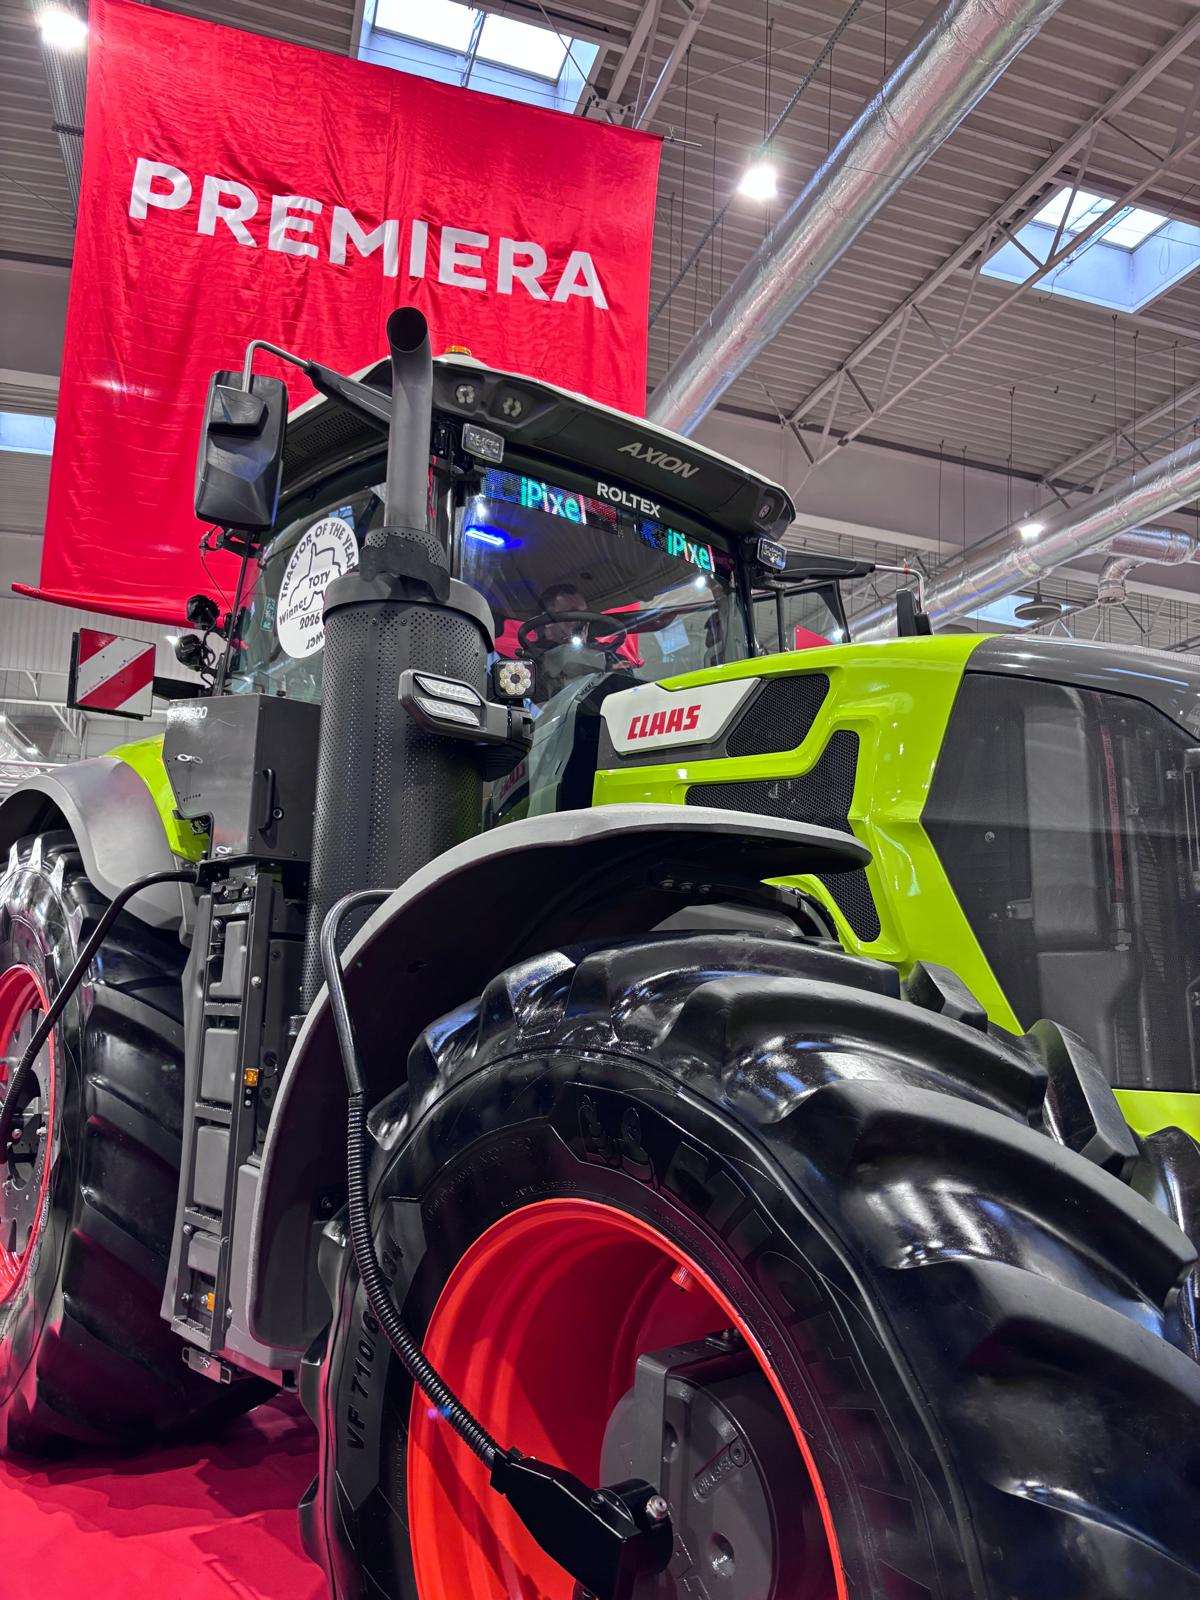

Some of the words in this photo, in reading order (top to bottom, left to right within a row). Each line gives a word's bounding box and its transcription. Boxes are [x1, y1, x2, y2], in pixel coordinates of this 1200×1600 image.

[128, 157, 609, 310] PREMIERA
[617, 442, 700, 479] AXION
[521, 476, 587, 525] iPixel
[596, 481, 661, 519] ROLTEX
[281, 533, 312, 600] TRACTOR
[315, 523, 327, 538] OF
[329, 522, 346, 541] THE
[667, 529, 716, 573] iPixel
[308, 570, 331, 589] TOTY
[279, 597, 308, 626] Winner
[299, 612, 320, 631] 2026
[627, 704, 701, 740] CLAAS
